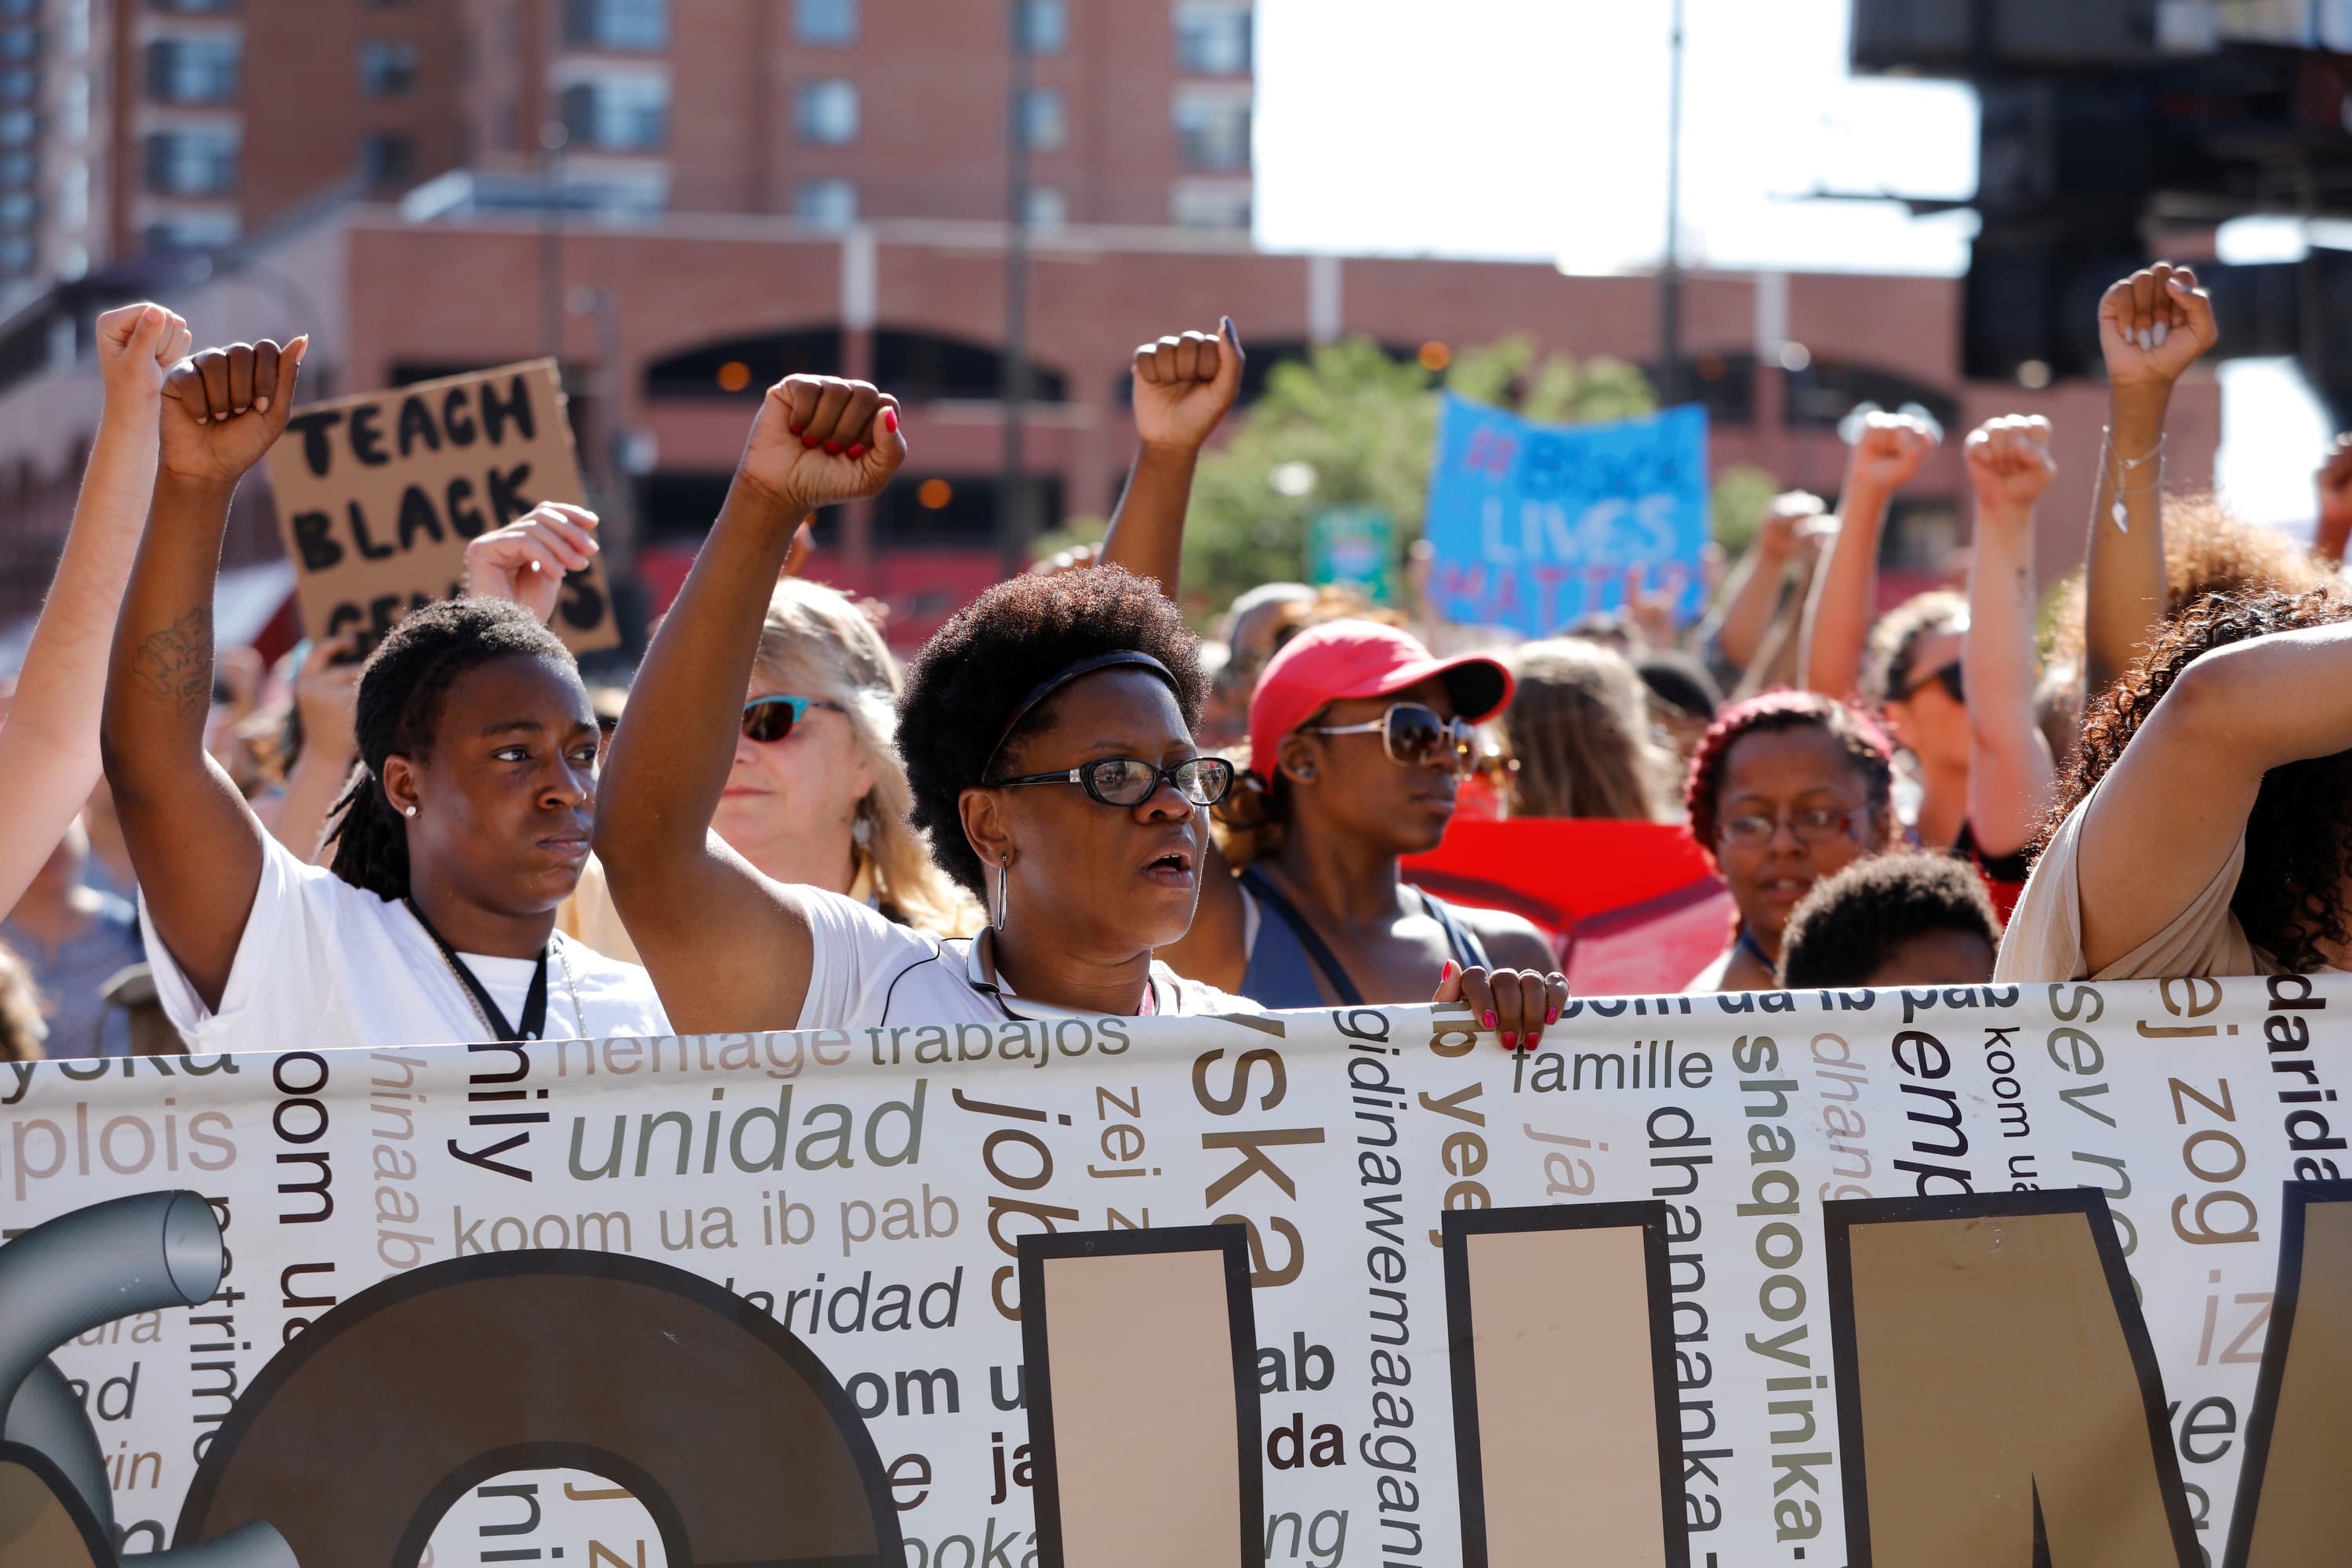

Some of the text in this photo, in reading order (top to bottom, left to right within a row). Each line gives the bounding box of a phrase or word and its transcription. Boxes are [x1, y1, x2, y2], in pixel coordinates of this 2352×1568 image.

[285, 374, 536, 478] TEACH
[293, 463, 539, 574] BLACK
[1481, 494, 1678, 564] LIVES
[865, 1017, 1131, 1069] trabajos
[1512, 1040, 1714, 1094] famille
[1984, 1026, 2031, 1138] koom
[2047, 983, 2117, 1129] sev
[568, 1078, 928, 1181] unidad
[1087, 1086, 1162, 1179] zej
[1192, 1012, 1326, 1289] ska
[2168, 1077, 2259, 1245] zog
[453, 1183, 960, 1258] koom ua ib pab
[724, 1265, 964, 1335] ridad
[1333, 1008, 1423, 1568] gidinawemaagan
[1732, 1035, 1833, 1544] shaqooyinka
[1255, 1331, 1334, 1394] ab
[103, 1440, 163, 1492] in
[1266, 1412, 1347, 1470] da
